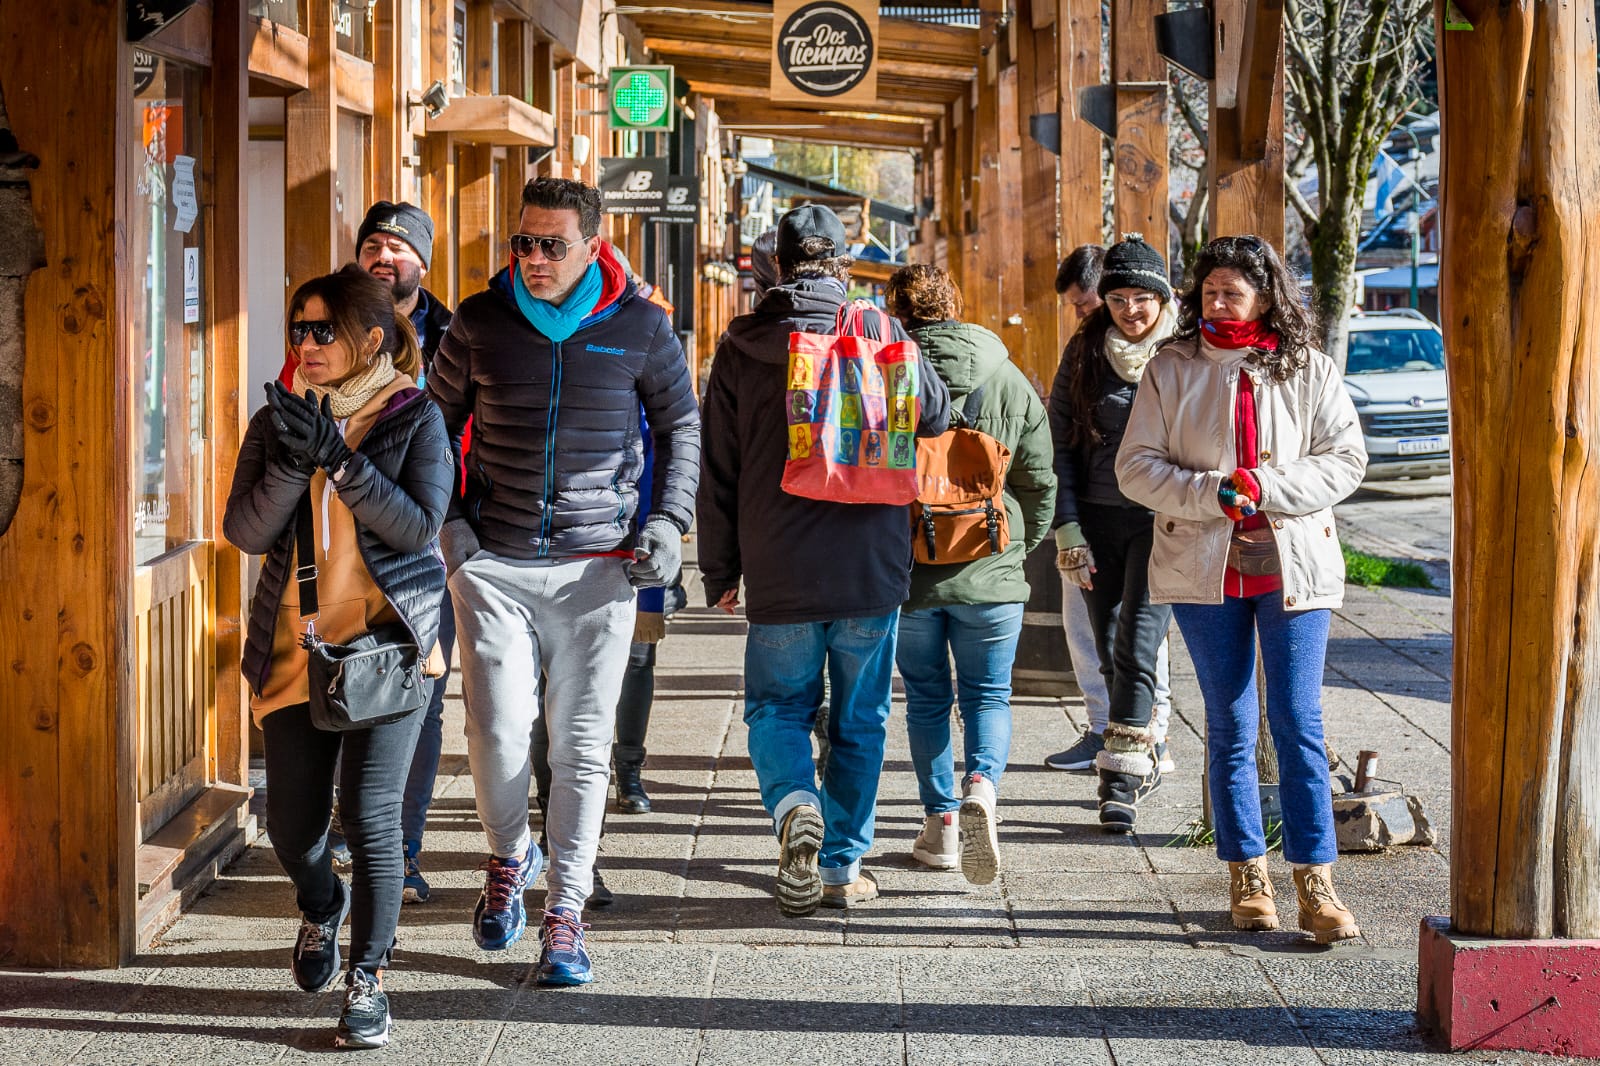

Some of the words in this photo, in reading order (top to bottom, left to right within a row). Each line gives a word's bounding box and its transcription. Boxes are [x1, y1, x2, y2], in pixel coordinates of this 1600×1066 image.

[812, 23, 848, 46] Dos
[782, 35, 868, 72] Tiempos
[621, 170, 653, 191] NB
